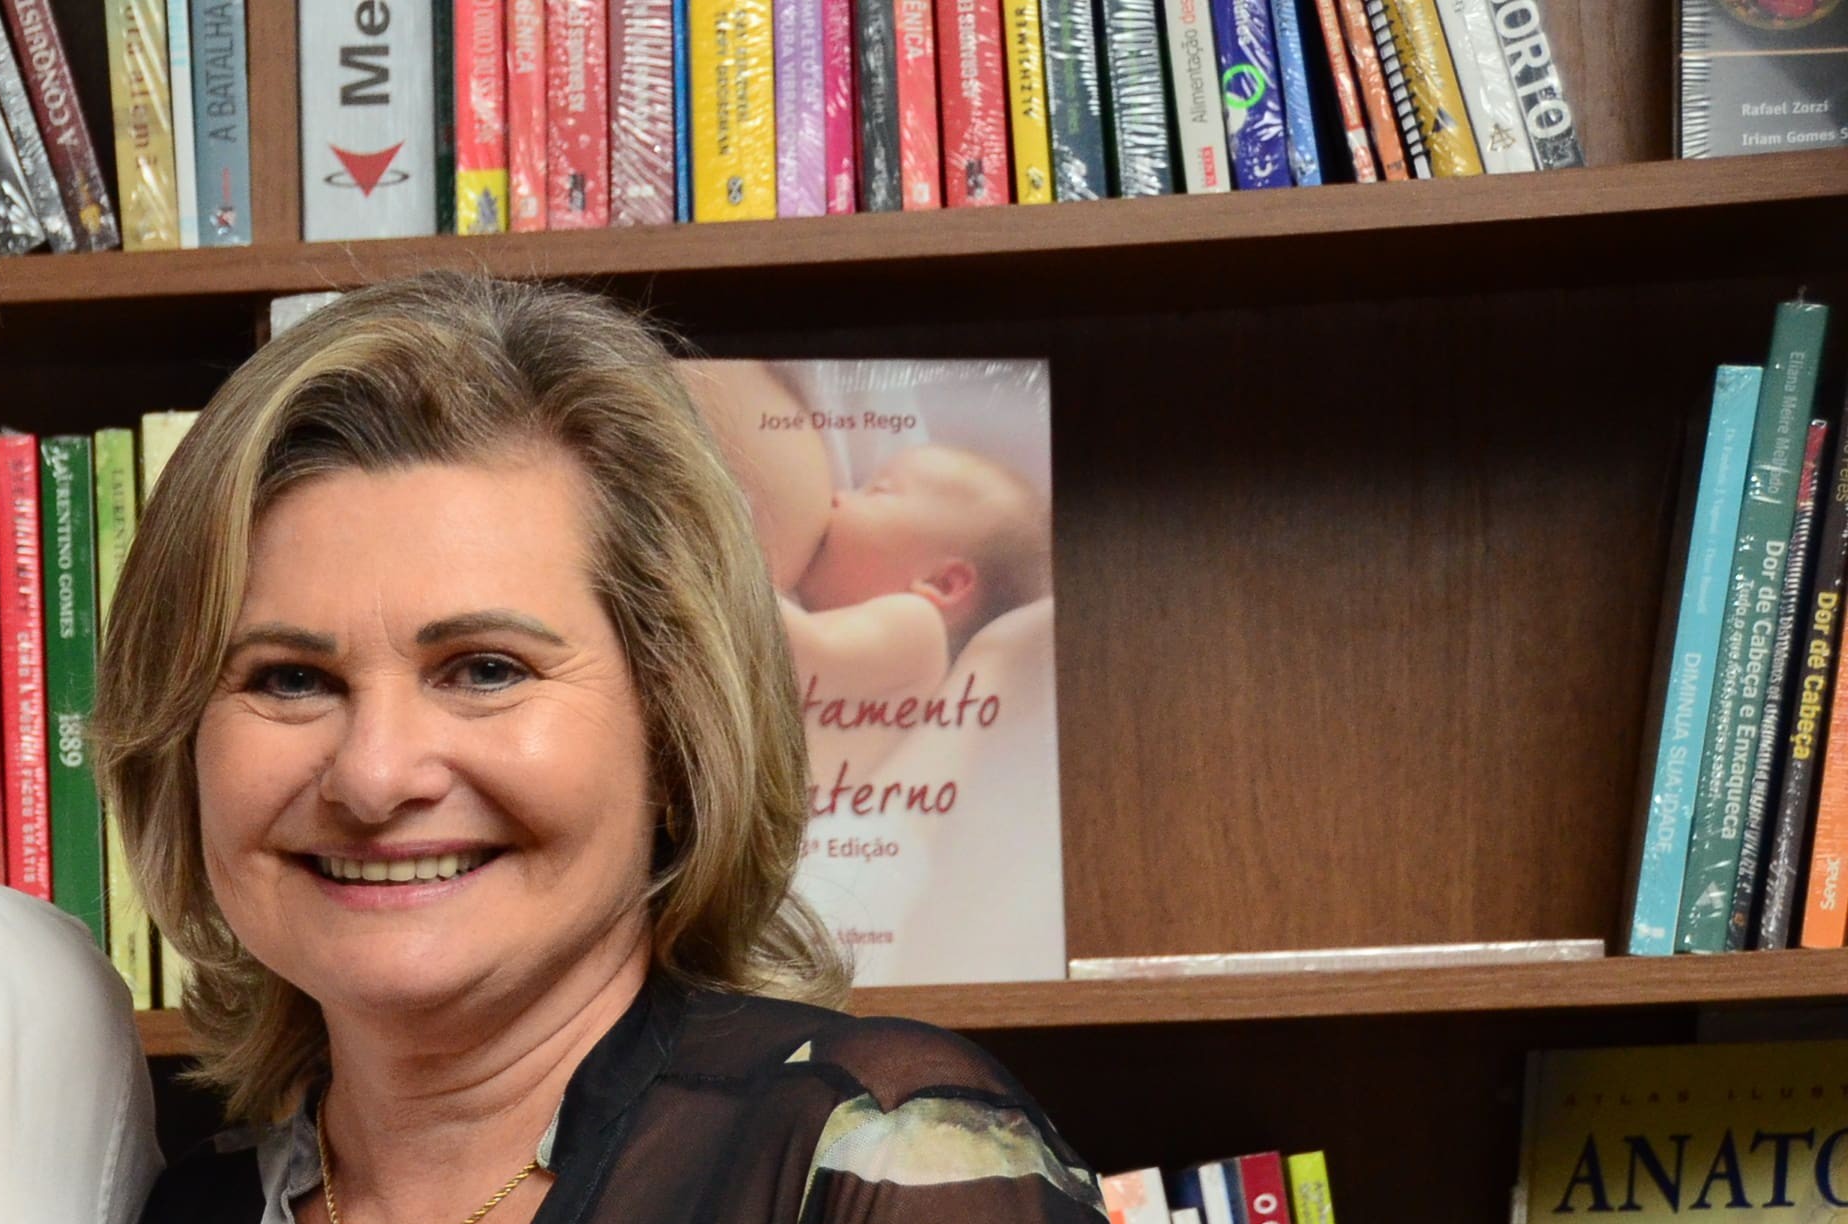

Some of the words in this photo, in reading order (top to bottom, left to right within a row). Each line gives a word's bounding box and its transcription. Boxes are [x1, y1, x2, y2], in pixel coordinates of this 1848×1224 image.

[203, 1, 236, 117] BATALHA
[1013, 4, 1034, 118] ALZHEIMER
[1179, 26, 1213, 125] Alimentação
[1741, 101, 1787, 116] Rafael
[56, 128, 80, 149] A
[206, 125, 237, 142] A
[1786, 130, 1835, 144] Gomes
[1781, 349, 1806, 395] Eliana
[758, 410, 804, 431] José
[811, 410, 857, 430] Dias
[863, 410, 917, 434] Rego
[52, 446, 73, 570] LAURENTINO
[1758, 538, 1787, 583] Dor
[58, 573, 73, 639] GOMES
[1753, 583, 1779, 615] de
[1812, 589, 1838, 635] Dor
[1736, 615, 1773, 698] Cabeça
[1806, 638, 1831, 673] de
[1669, 650, 1704, 742] DIMINUA
[1738, 701, 1754, 718] e
[52, 710, 87, 769] 1889
[1786, 673, 1825, 768] Cabeça
[1662, 743, 1688, 791] SUA
[1713, 719, 1757, 840] Enxaqueca
[826, 836, 901, 862] Edição
[1250, 1192, 1277, 1217] O
